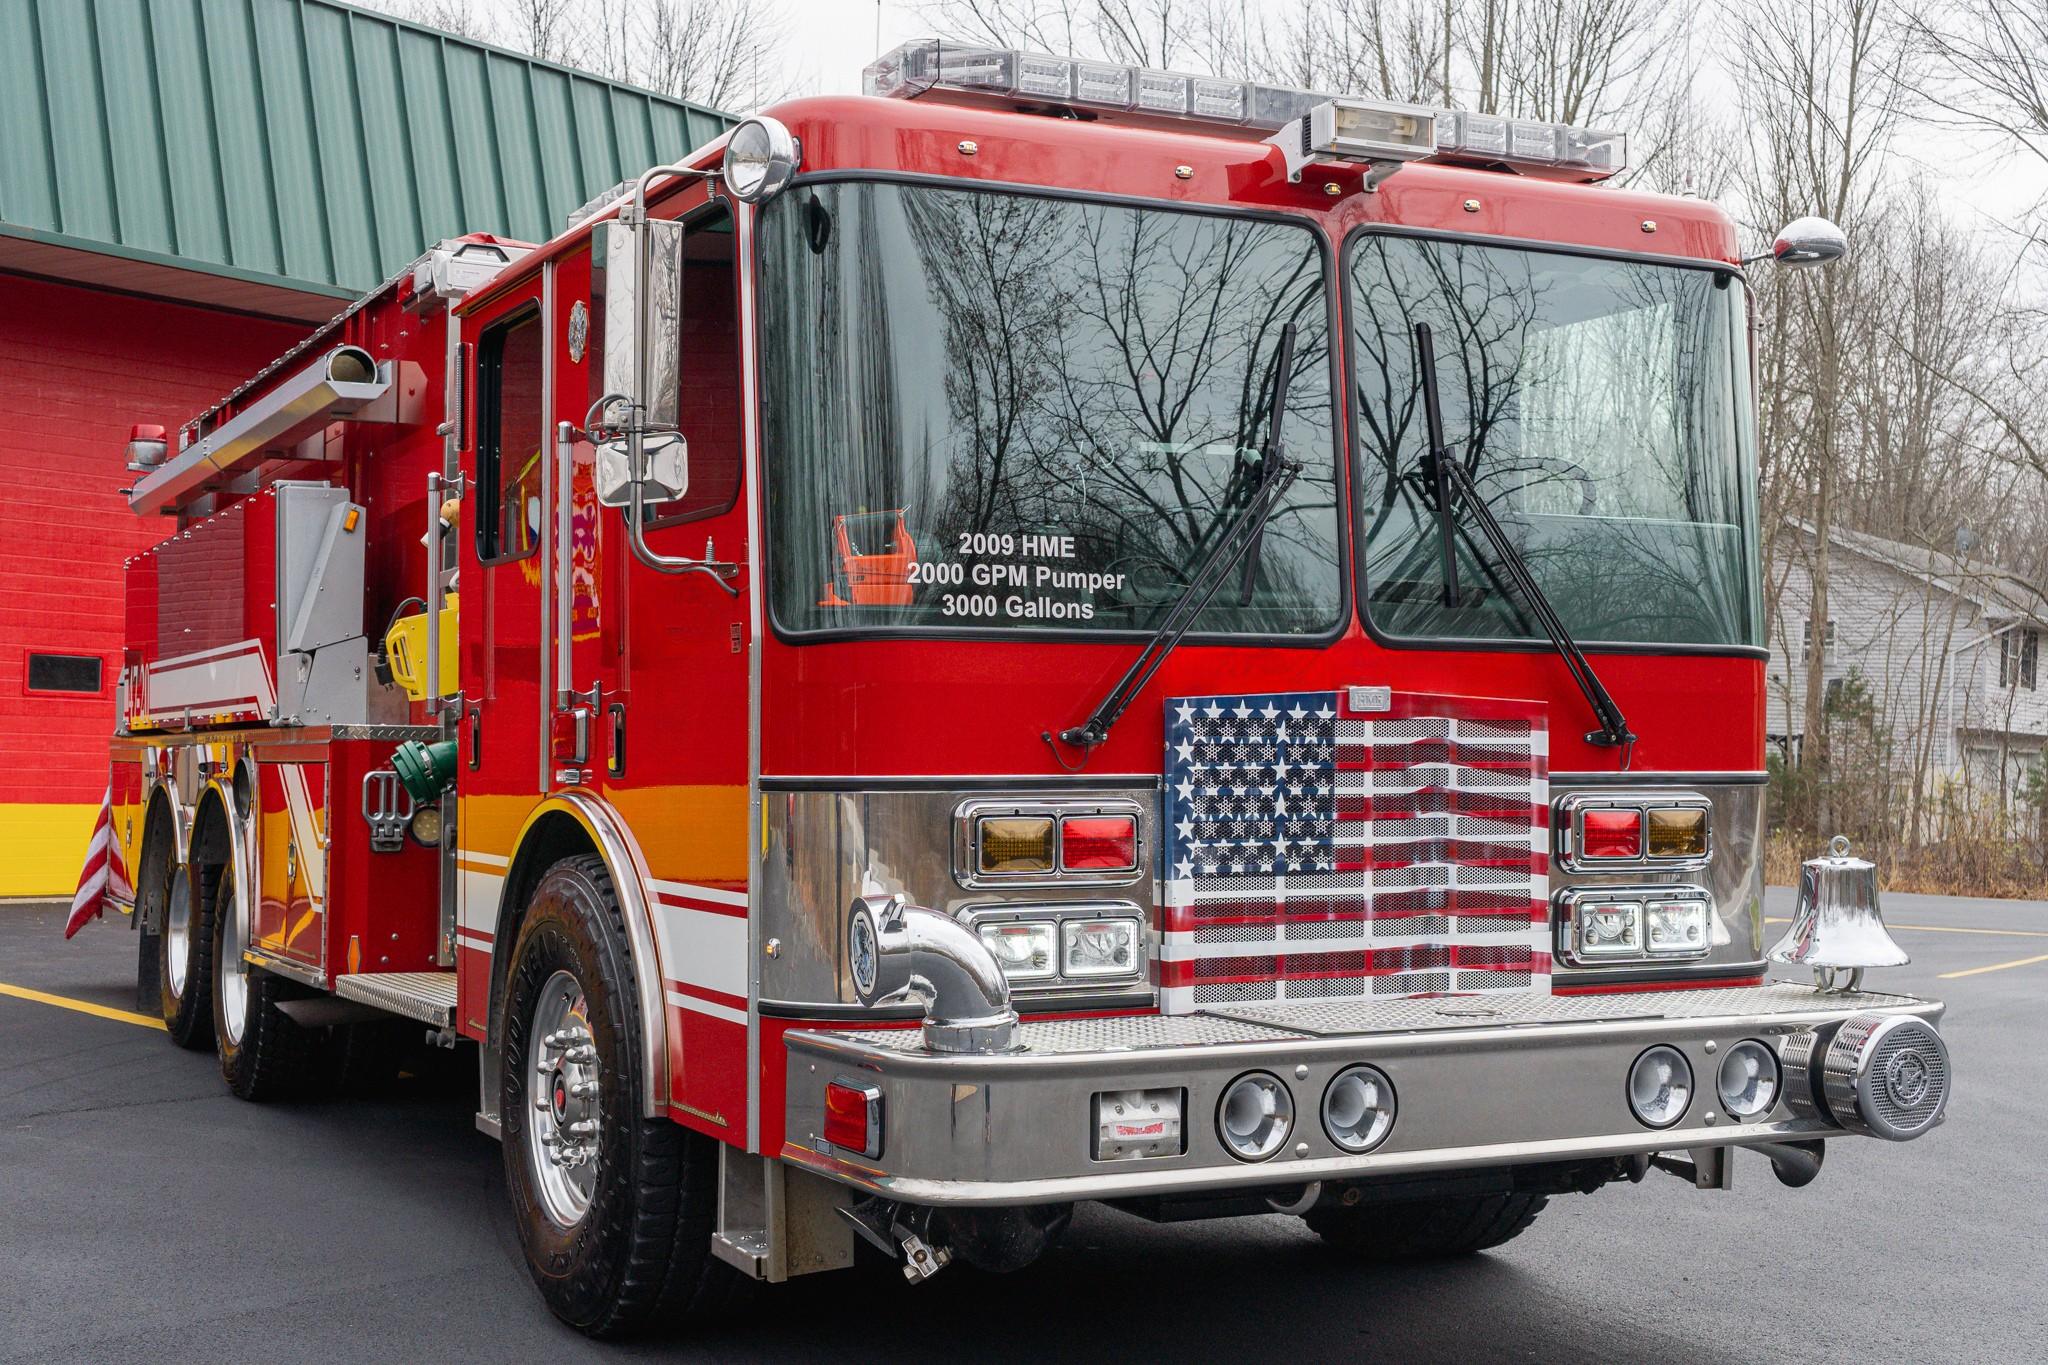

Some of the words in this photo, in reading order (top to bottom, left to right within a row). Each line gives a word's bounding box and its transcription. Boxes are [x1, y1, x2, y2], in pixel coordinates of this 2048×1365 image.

[958, 532, 1015, 556] 2009
[1022, 535, 1076, 558] HME
[906, 562, 964, 585] 2000
[971, 563, 1028, 587] GPM
[1035, 565, 1126, 594] Pumper
[942, 594, 998, 617] 3000
[1005, 595, 1094, 619] Gallons
